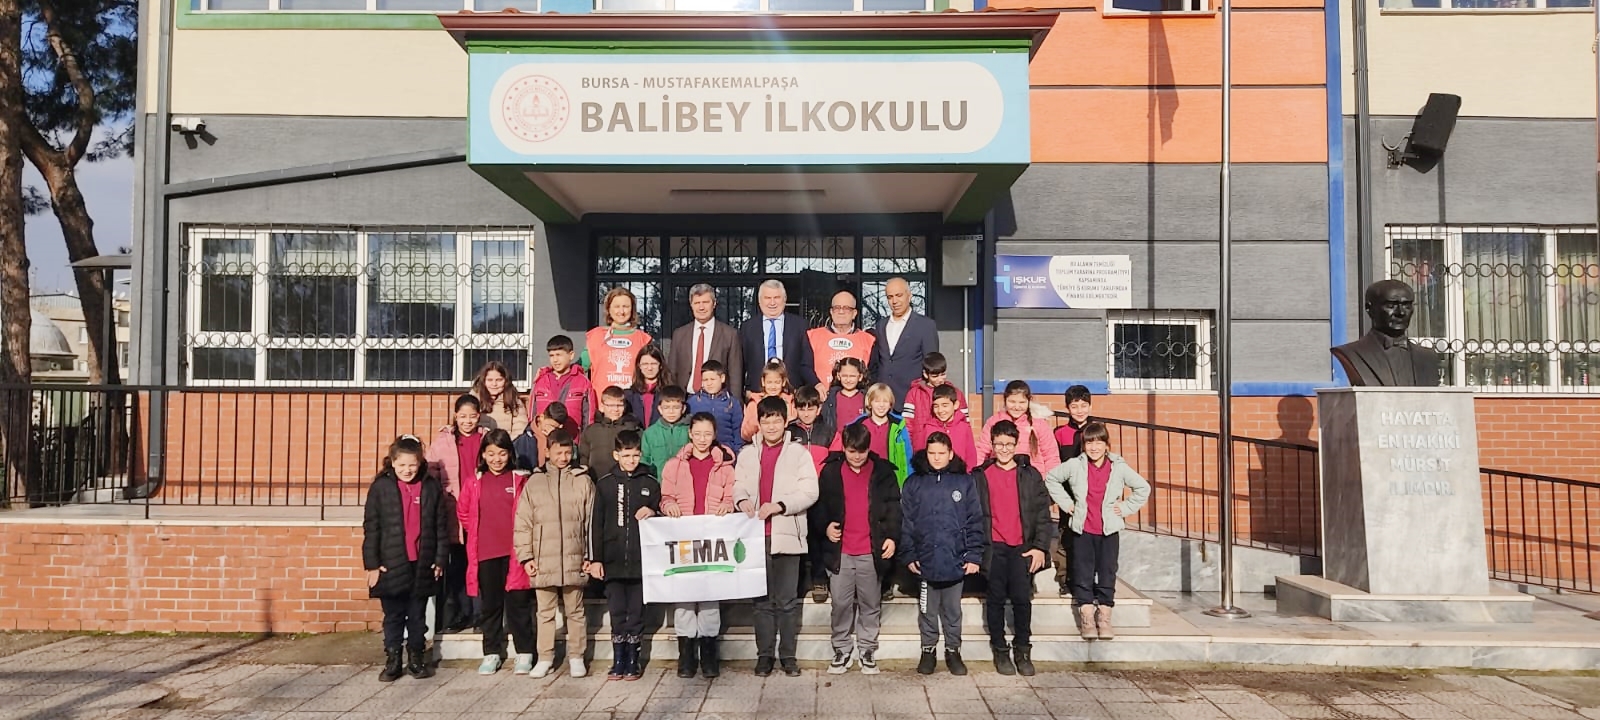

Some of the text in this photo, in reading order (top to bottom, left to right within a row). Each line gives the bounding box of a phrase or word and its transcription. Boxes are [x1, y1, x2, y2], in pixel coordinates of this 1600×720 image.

[581, 77, 630, 89] BURSA
[643, 77, 799, 91] MUSTAFAKEMALPAŞA
[581, 94, 751, 133] BALİBEY
[765, 94, 968, 132] İLKOKULU
[1381, 411, 1453, 426] HAYATTA
[1378, 434, 1400, 449] EN
[665, 538, 729, 564] TEMA
